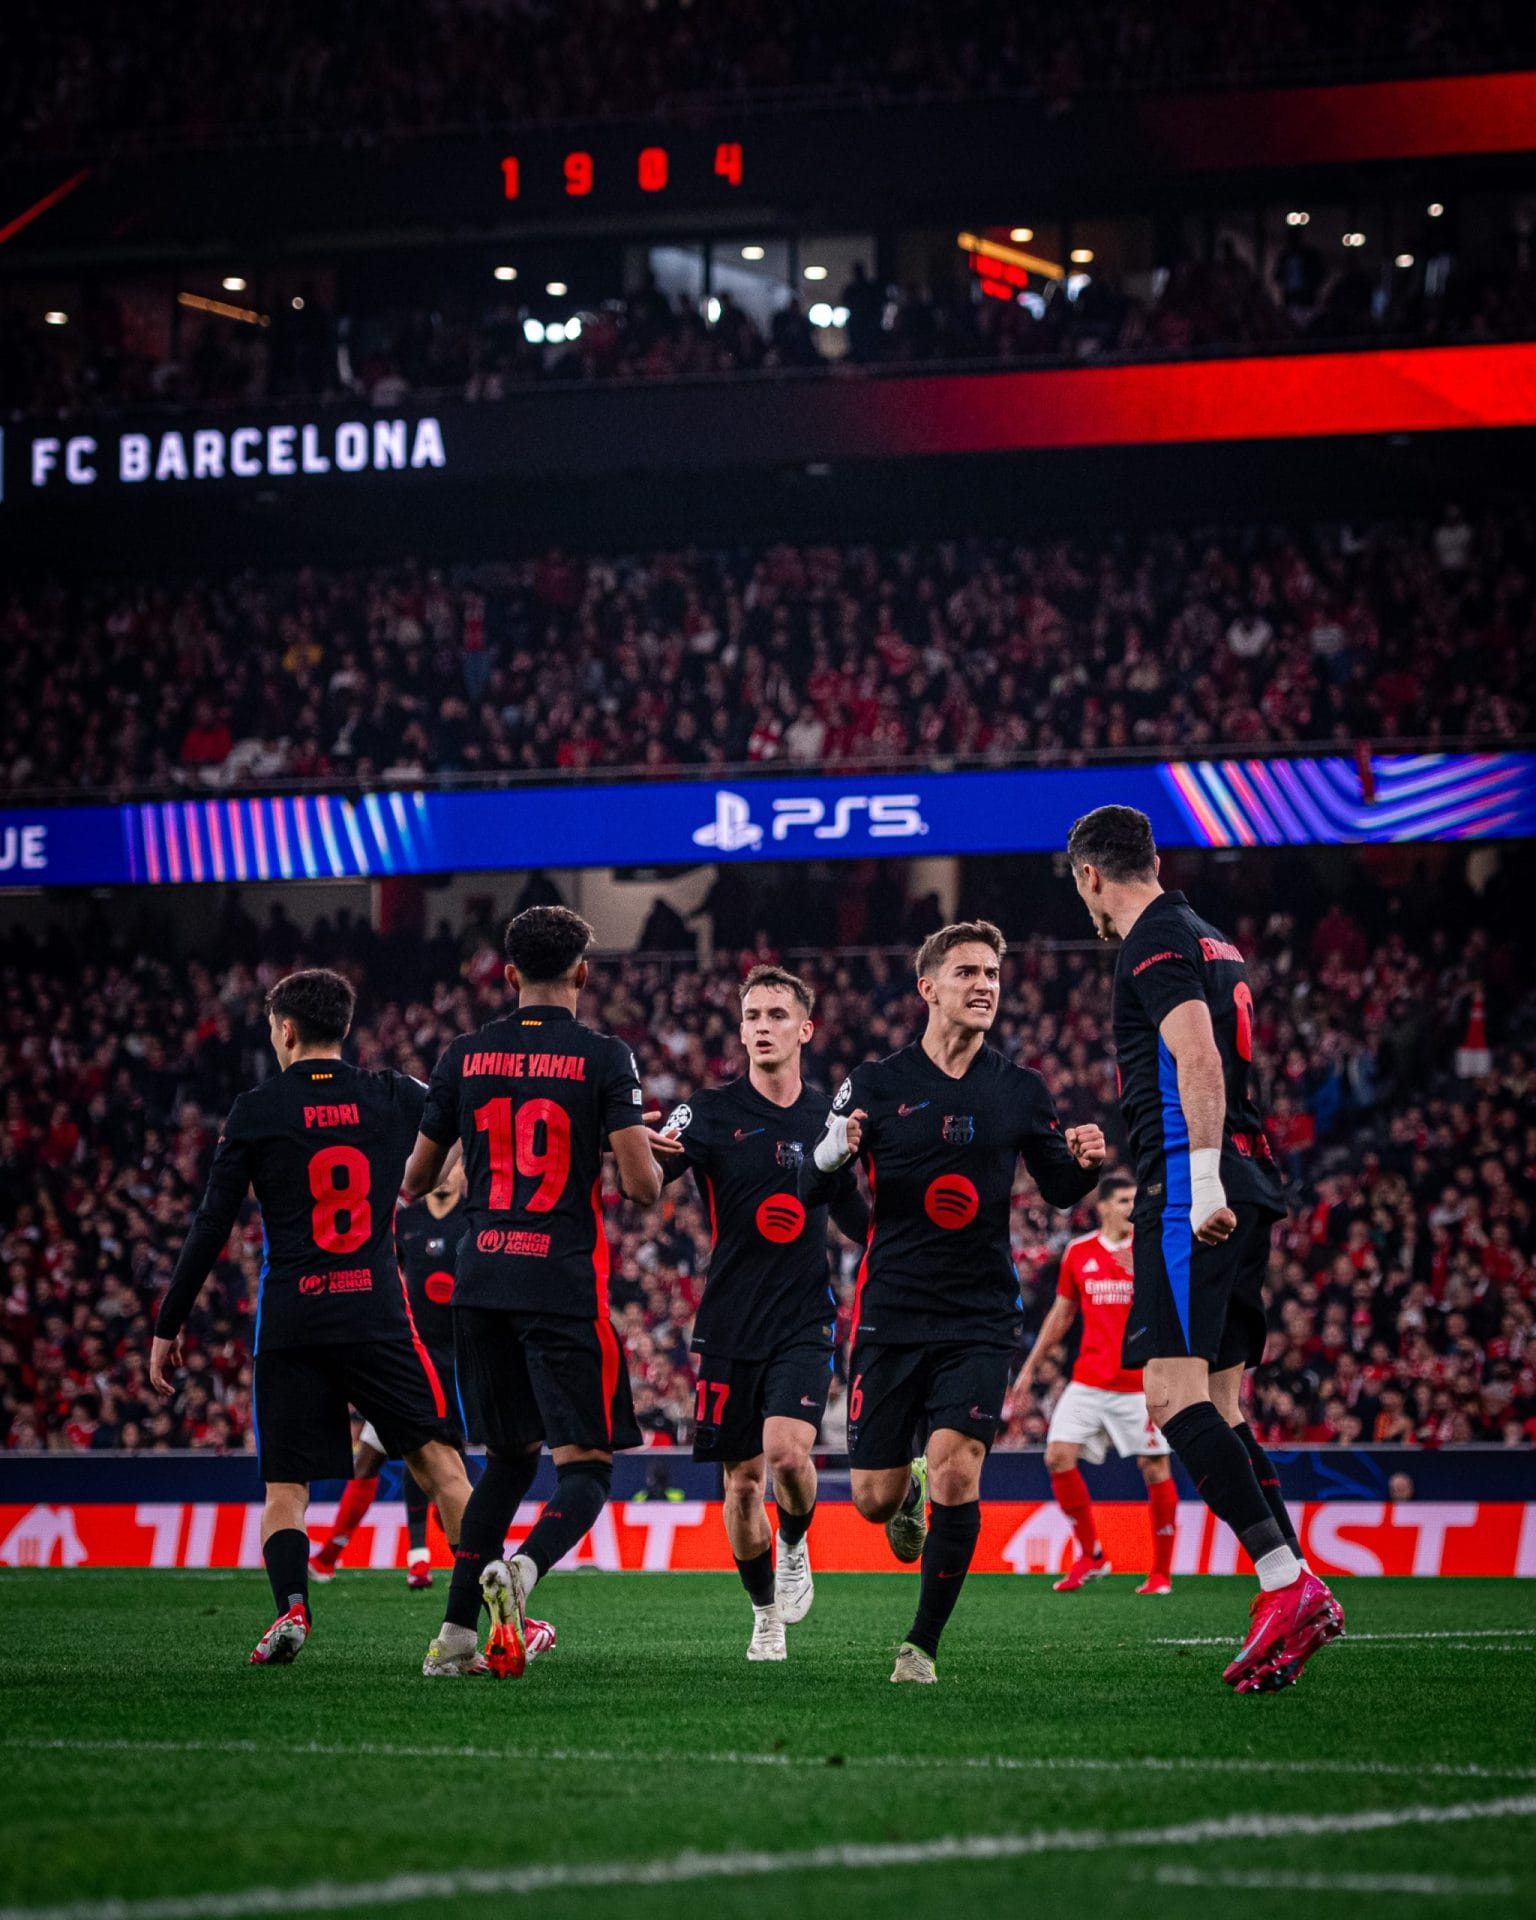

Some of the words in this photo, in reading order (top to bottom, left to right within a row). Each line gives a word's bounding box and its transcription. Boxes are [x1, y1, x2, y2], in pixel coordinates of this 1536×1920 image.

[31, 436, 97, 486] FC
[119, 417, 446, 482] BARCELONA
[772, 795, 921, 840] PS5
[462, 1052, 526, 1078] LAMINE
[528, 1054, 586, 1081] YAMAL
[303, 1103, 360, 1128] PEDRI
[474, 1097, 571, 1213] 19
[308, 1145, 372, 1254] 8
[695, 1379, 730, 1425] 17
[850, 1374, 864, 1421] 6
